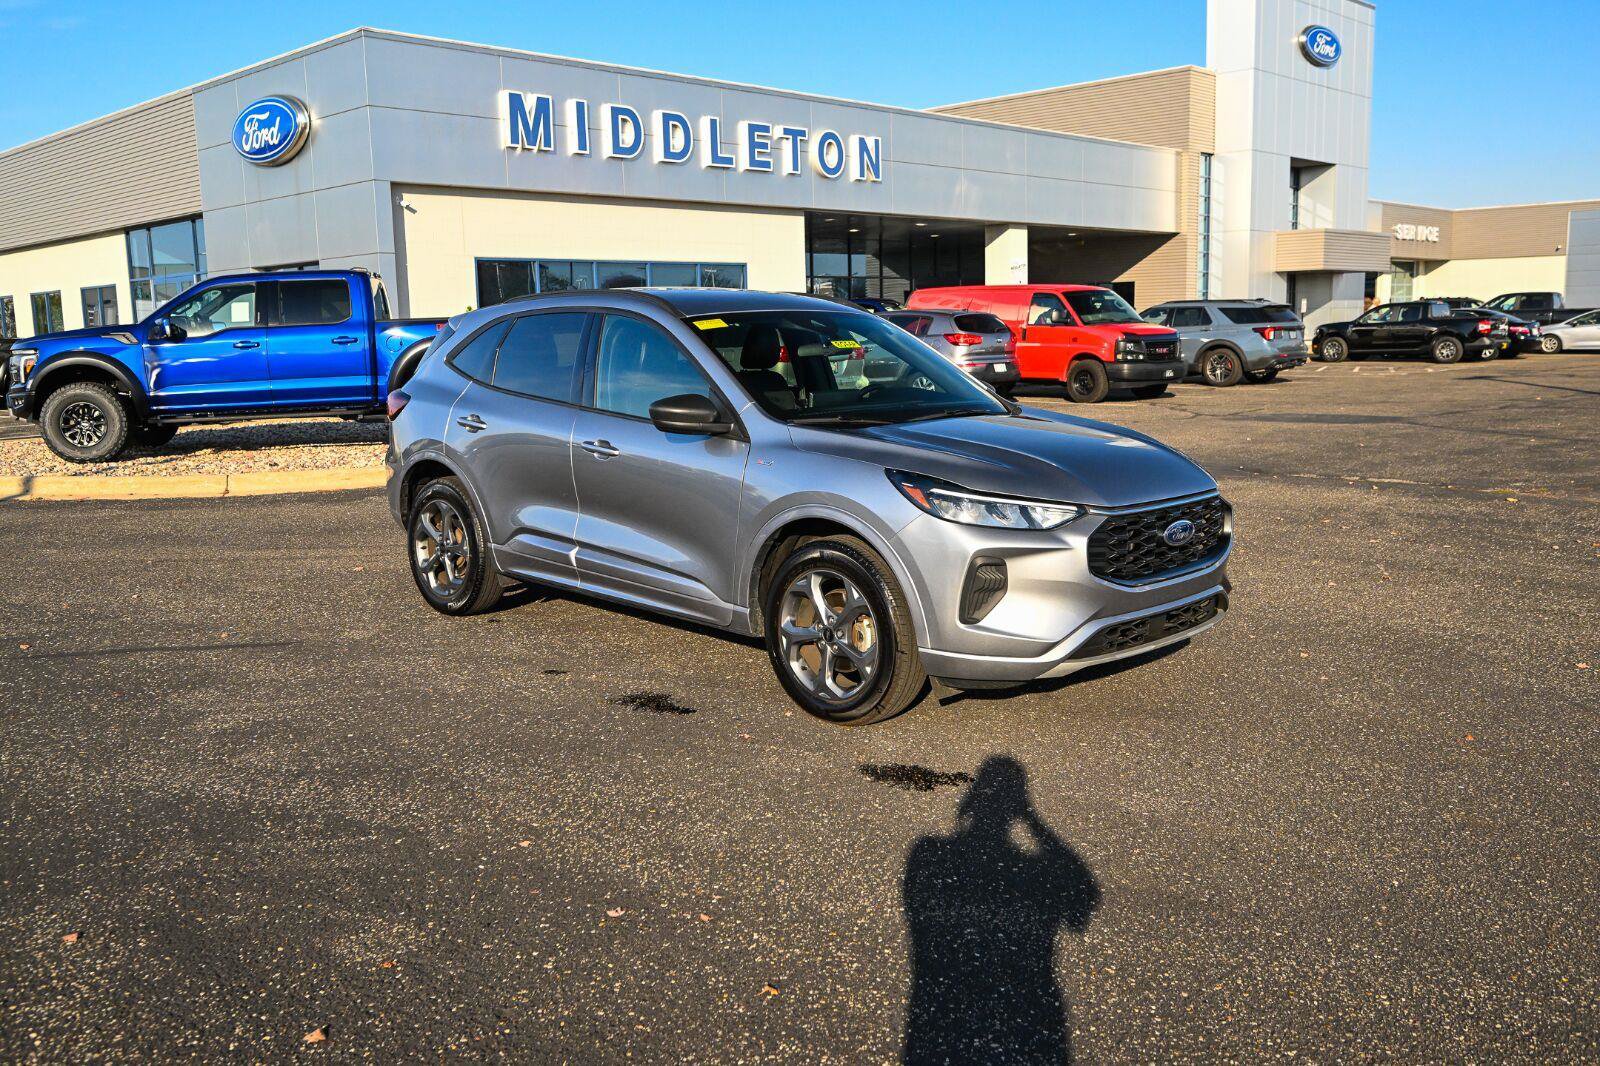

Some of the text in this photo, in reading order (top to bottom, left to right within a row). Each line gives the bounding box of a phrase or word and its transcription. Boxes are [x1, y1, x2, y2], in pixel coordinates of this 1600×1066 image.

[1313, 32, 1337, 58] Ford
[242, 111, 281, 152] Ford
[501, 90, 882, 183] MIDDLETON
[1395, 223, 1440, 242] SERVICE
